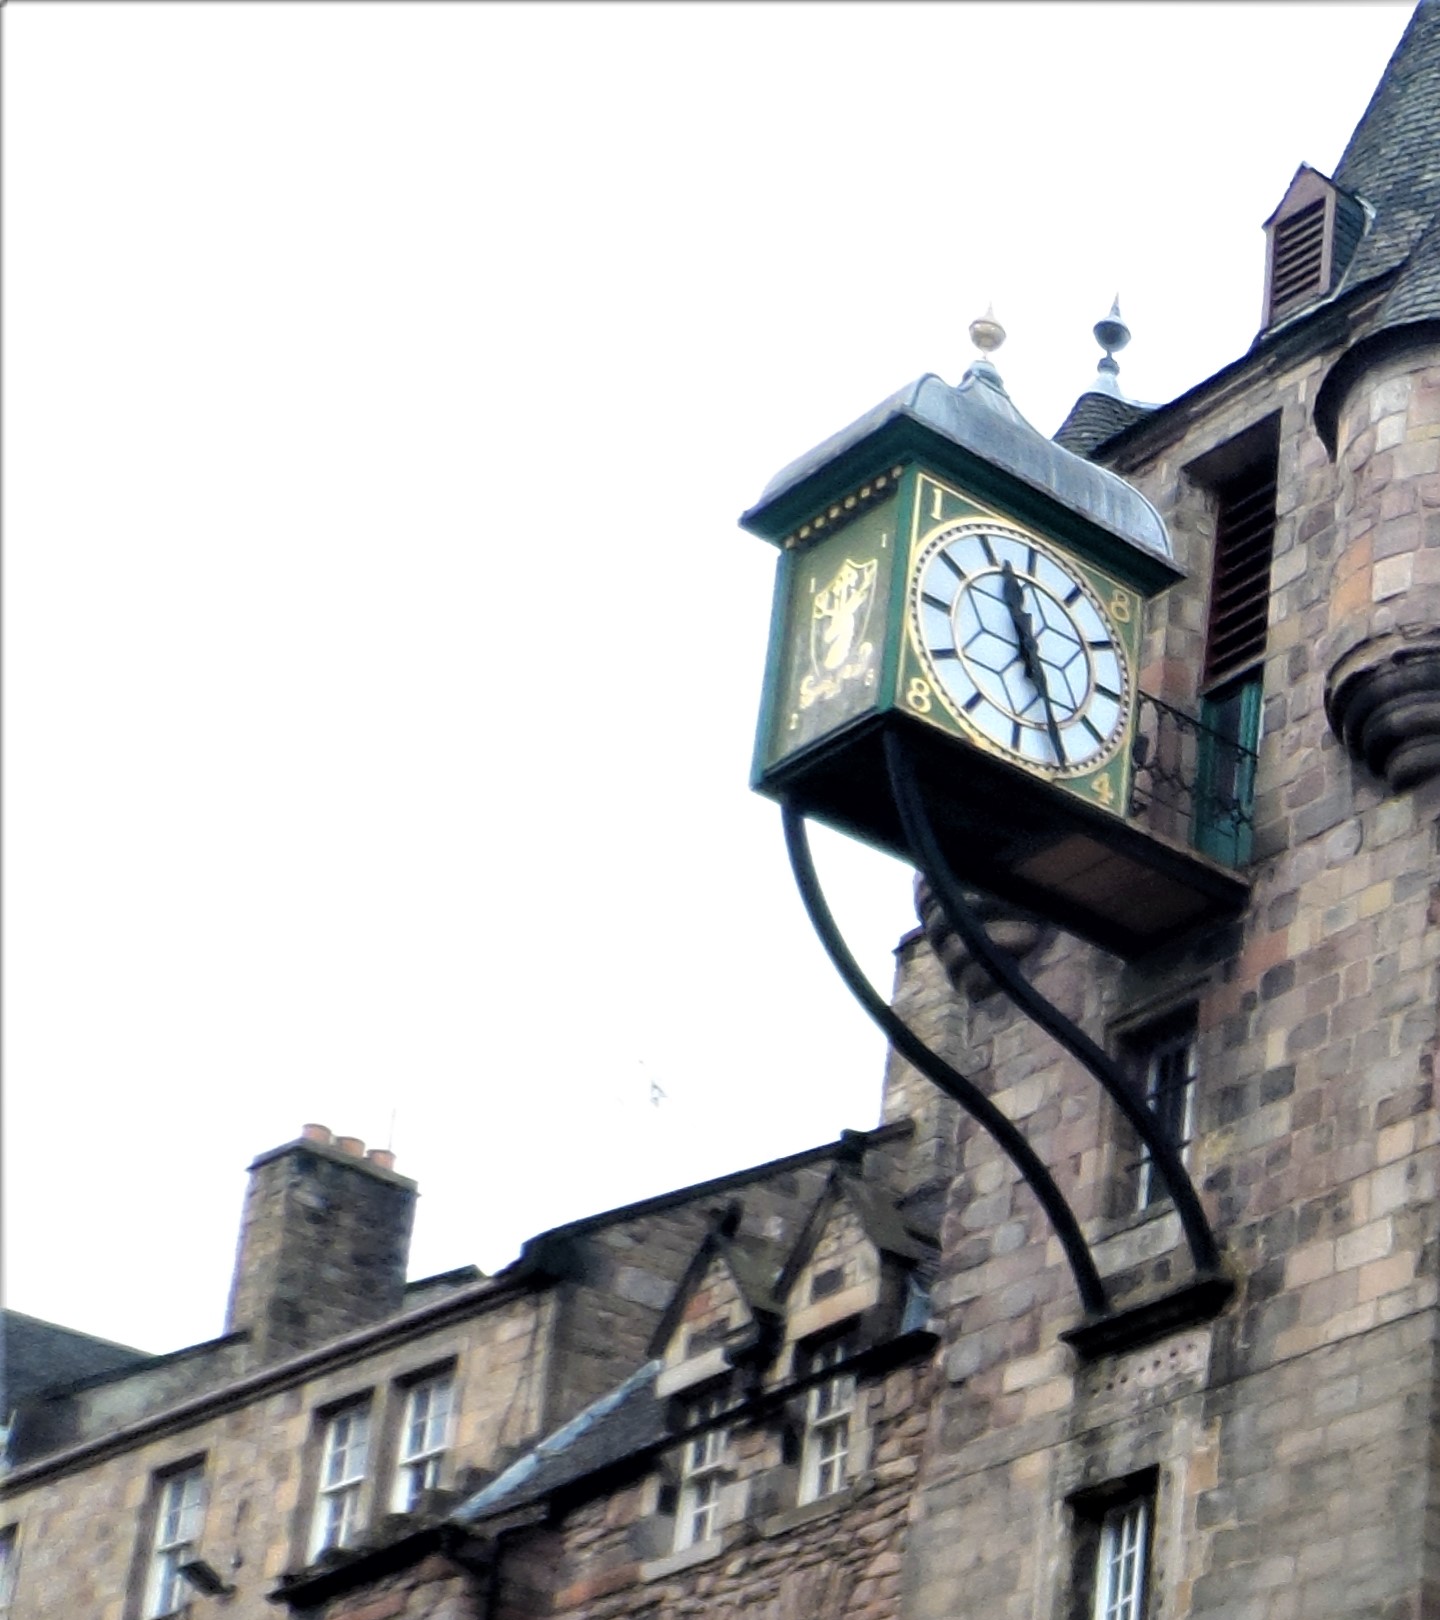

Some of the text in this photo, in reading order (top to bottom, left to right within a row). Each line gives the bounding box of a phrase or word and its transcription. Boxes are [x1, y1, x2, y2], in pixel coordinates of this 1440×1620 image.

[931, 488, 942, 520] 1
[1110, 589, 1131, 623] 8
[906, 677, 932, 714] 8
[1091, 772, 1115, 805] 4
